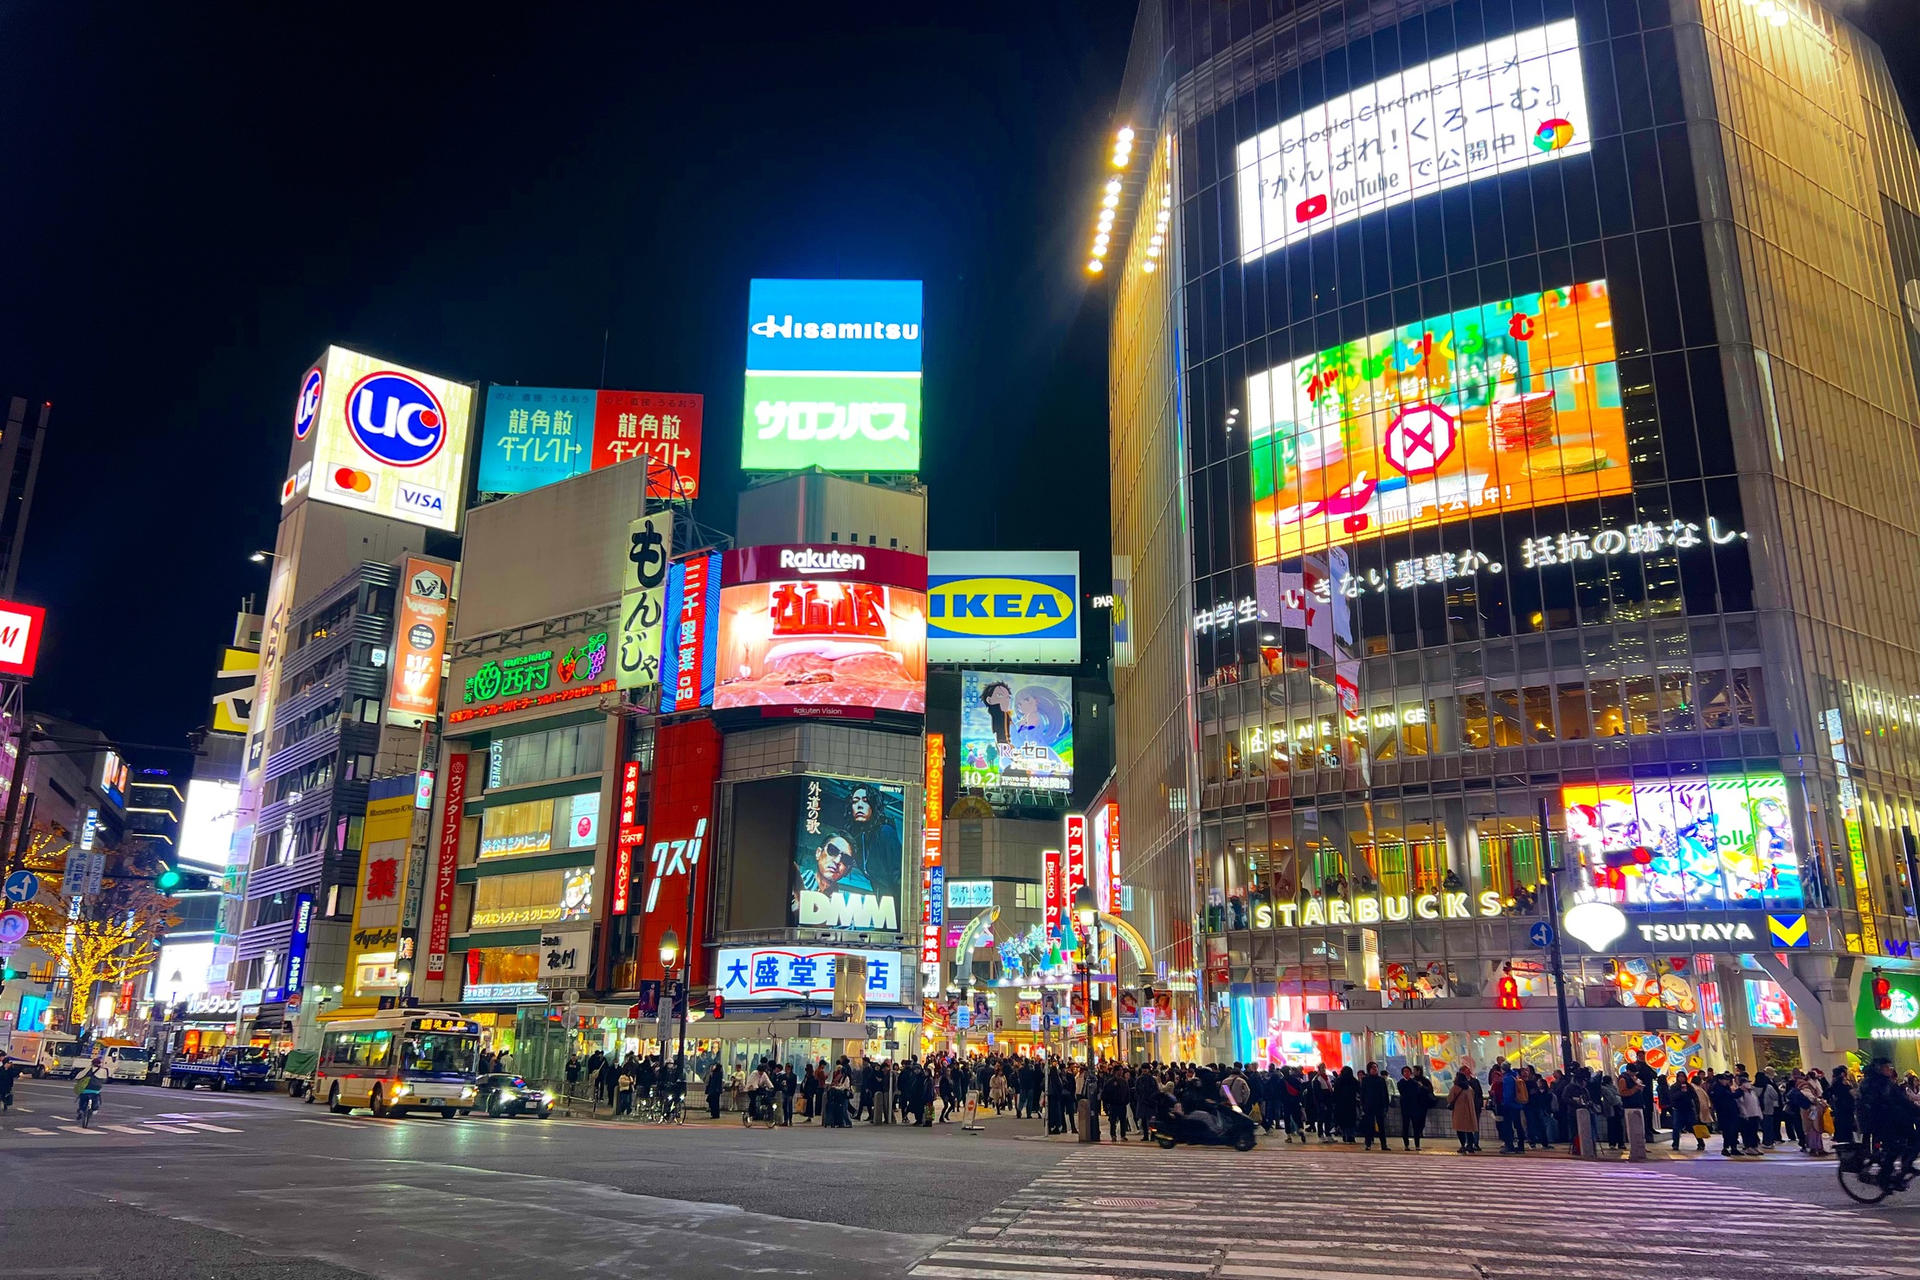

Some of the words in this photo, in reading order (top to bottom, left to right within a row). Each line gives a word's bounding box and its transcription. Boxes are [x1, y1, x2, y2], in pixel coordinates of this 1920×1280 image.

[1281, 115, 1351, 156] Google
[1358, 81, 1444, 122] Chrome
[1452, 54, 1520, 89] アニメ
[1331, 169, 1400, 209] YouTube
[1410, 134, 1517, 176] で公開中
[752, 314, 919, 341] Hisamitsu
[357, 388, 439, 448] UC
[508, 408, 574, 436] 龍角散
[617, 412, 682, 440] 龍角散
[754, 400, 910, 441] サロンパス
[402, 487, 443, 511] VISA
[780, 548, 866, 572] Rakuten
[620, 520, 667, 680] もんじゃ
[930, 594, 1062, 618] IKEA
[675, 563, 701, 701] 三千里薬品
[501, 661, 551, 696] 西村
[793, 707, 821, 716] Rakuten
[822, 707, 842, 716] Vision
[929, 737, 941, 821] クスリのことなら
[805, 781, 822, 835] 外道の歌
[439, 775, 462, 901] ウィンターフルーツギフト
[367, 858, 399, 901] 薬
[645, 818, 708, 913] クスリ
[951, 896, 992, 905] クリニック
[961, 885, 992, 894] れいわ
[298, 900, 311, 934] MIZUHO
[798, 889, 898, 930] DMM
[1255, 890, 1503, 929] STARBUCKS
[1638, 923, 1755, 942] TSUTAYA
